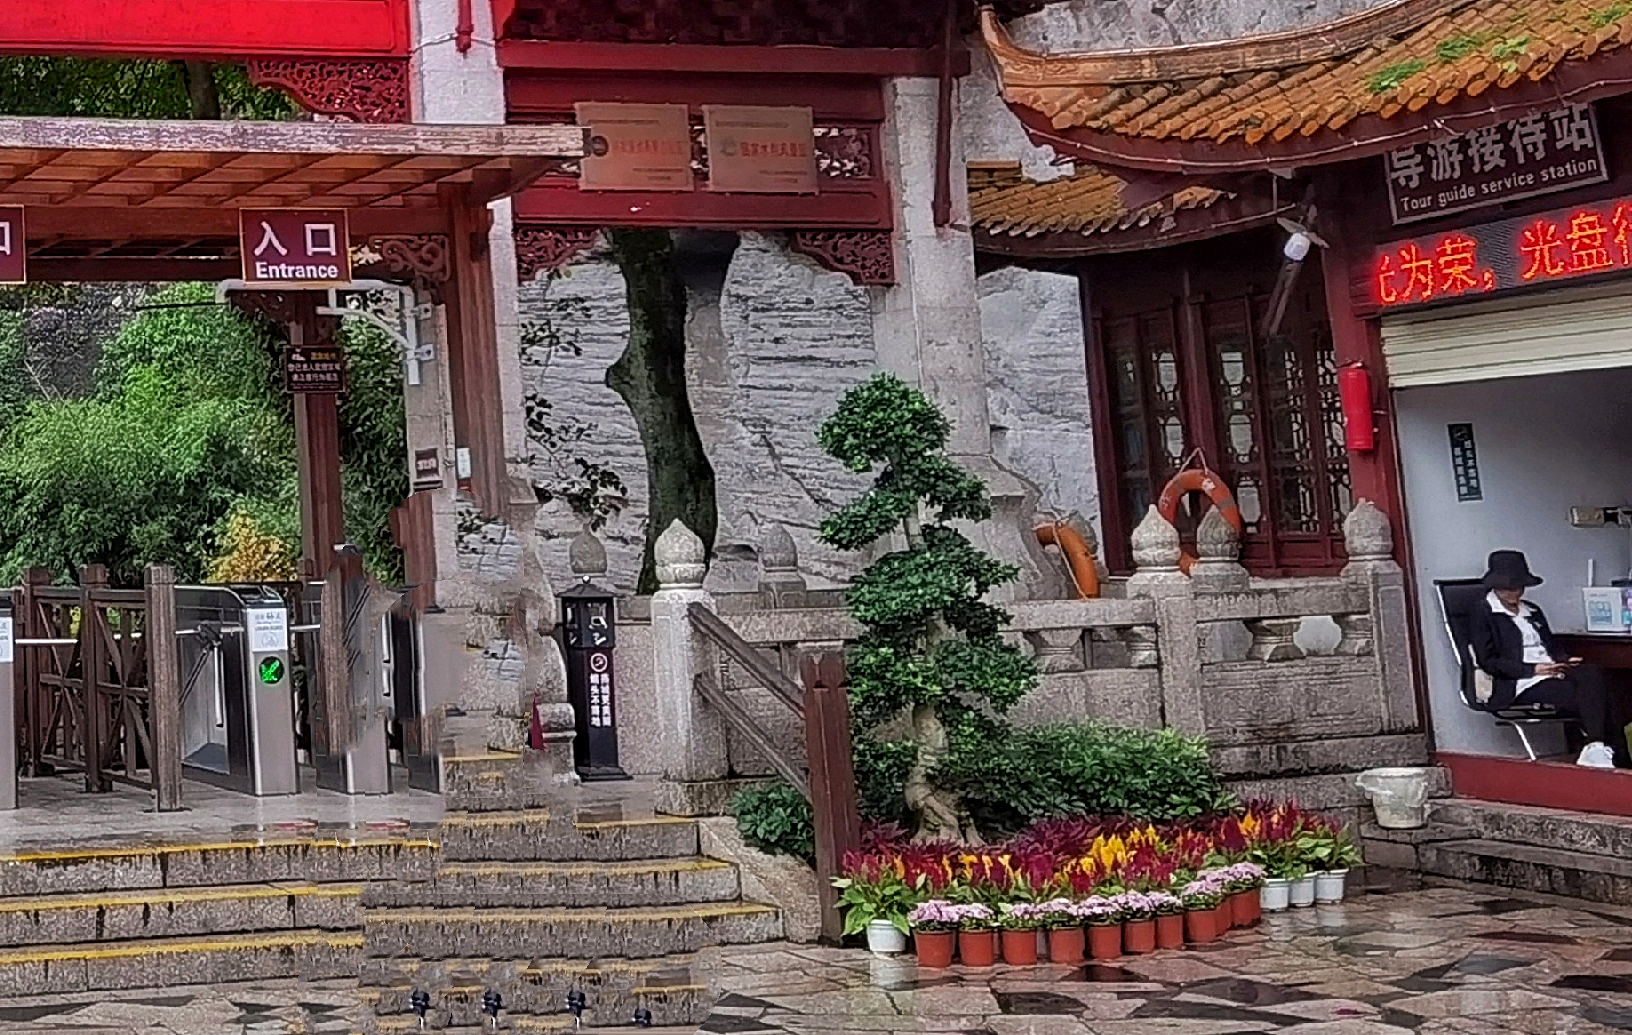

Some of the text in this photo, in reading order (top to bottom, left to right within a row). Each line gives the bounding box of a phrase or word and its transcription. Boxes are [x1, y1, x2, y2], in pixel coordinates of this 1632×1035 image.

[1389, 103, 1596, 189] 导游接待站
[1400, 158, 1598, 213] Tour guide service station
[253, 220, 338, 258] 入口
[254, 261, 339, 280] Entrance
